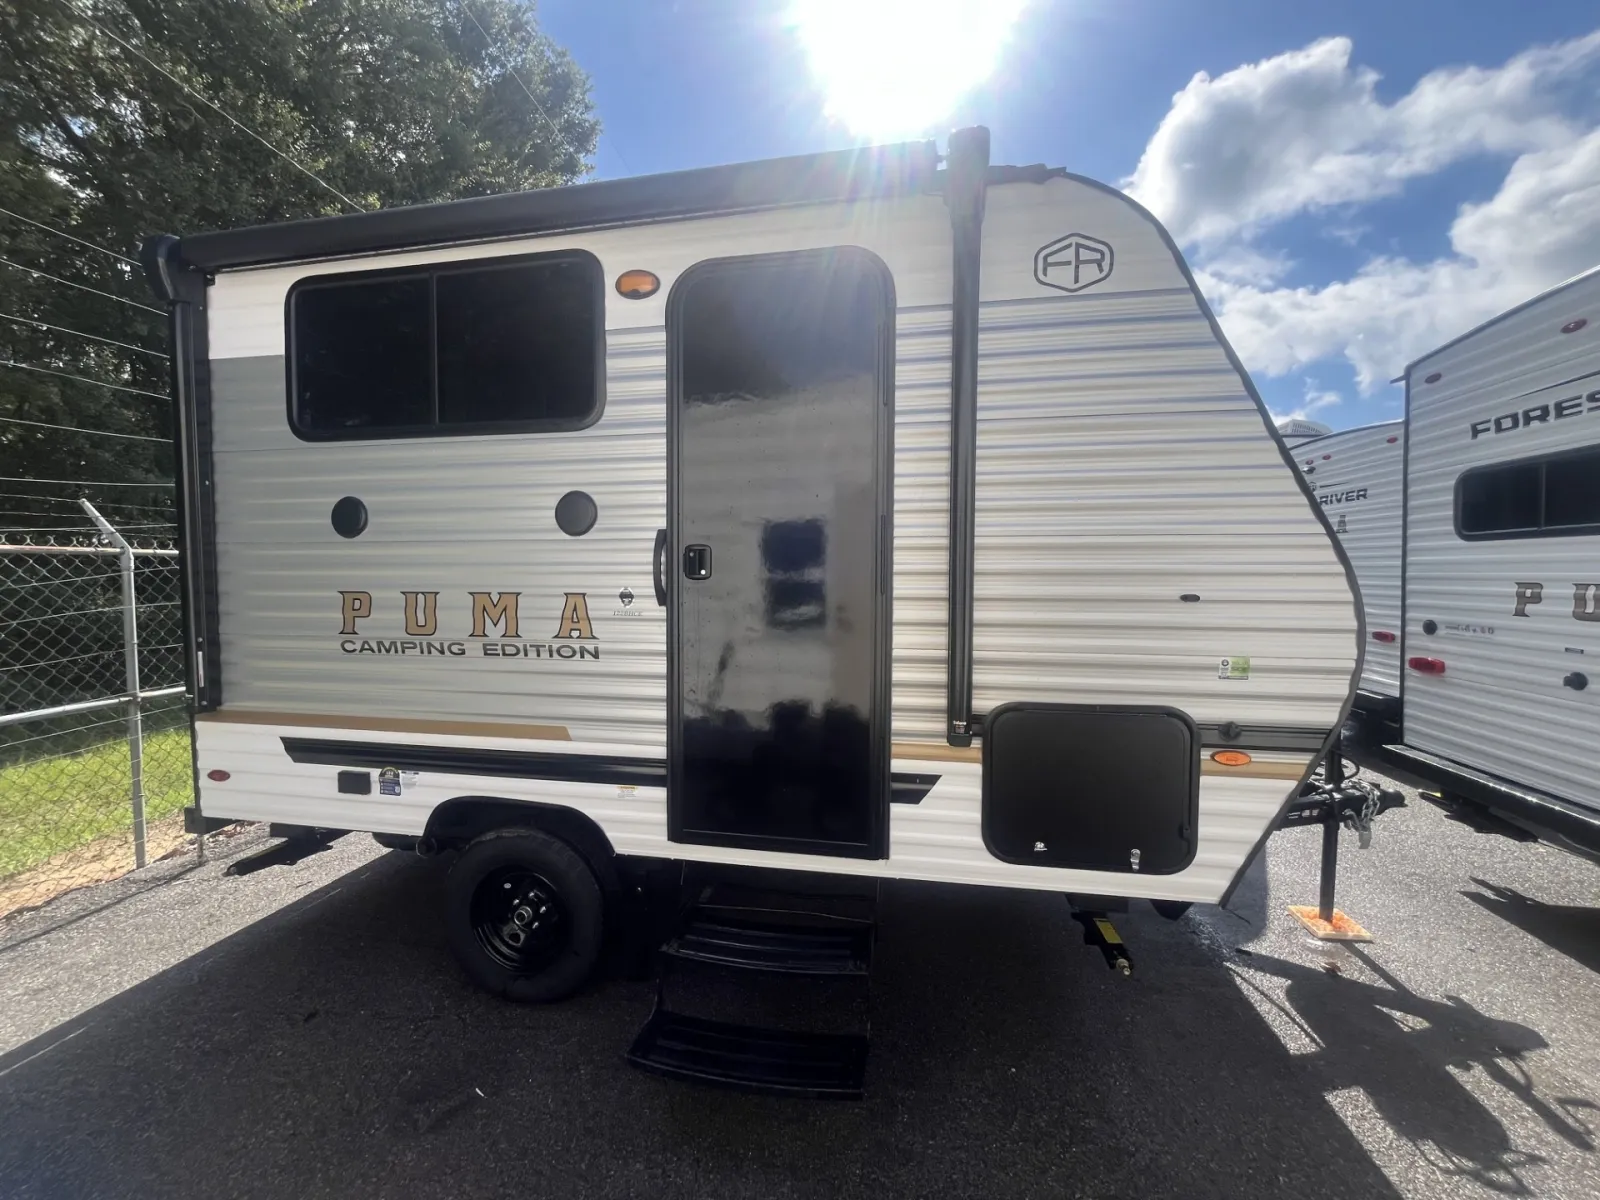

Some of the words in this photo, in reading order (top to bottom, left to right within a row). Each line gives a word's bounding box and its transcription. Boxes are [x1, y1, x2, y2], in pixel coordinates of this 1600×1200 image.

[1319, 488, 1368, 506] RIVER
[337, 590, 600, 639] PUMA
[340, 640, 466, 656] CAMPING
[482, 643, 600, 660] EDITION
